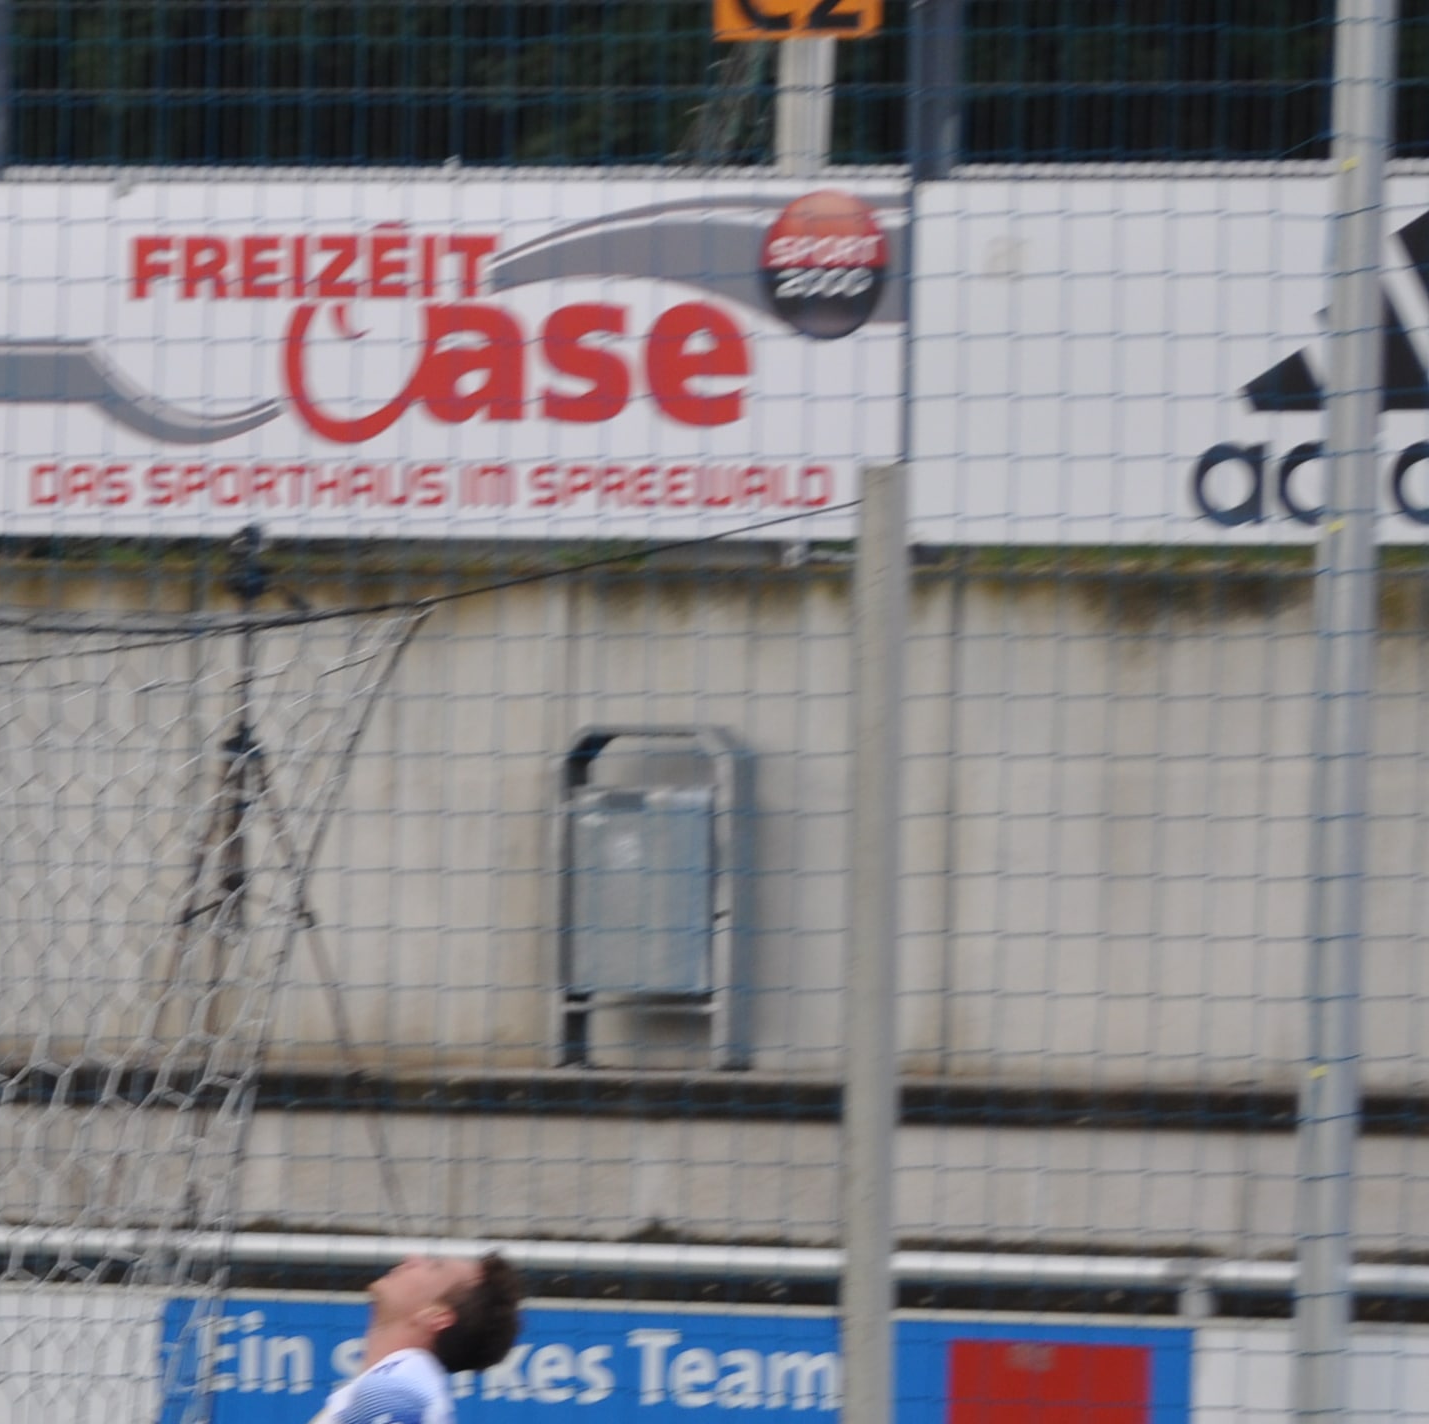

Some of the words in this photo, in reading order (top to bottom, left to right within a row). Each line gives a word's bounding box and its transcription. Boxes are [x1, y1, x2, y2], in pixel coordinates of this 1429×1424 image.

[127, 233, 498, 300] FREIZEIT
[767, 234, 885, 268] SPORT
[774, 265, 875, 299] 2000
[28, 462, 132, 507] DAS
[143, 462, 449, 508] SPORTHAUS
[459, 464, 516, 508] IM
[527, 464, 837, 510] SPREEWALD
[197, 1310, 316, 1394] Ein
[627, 1328, 842, 1410] Team
